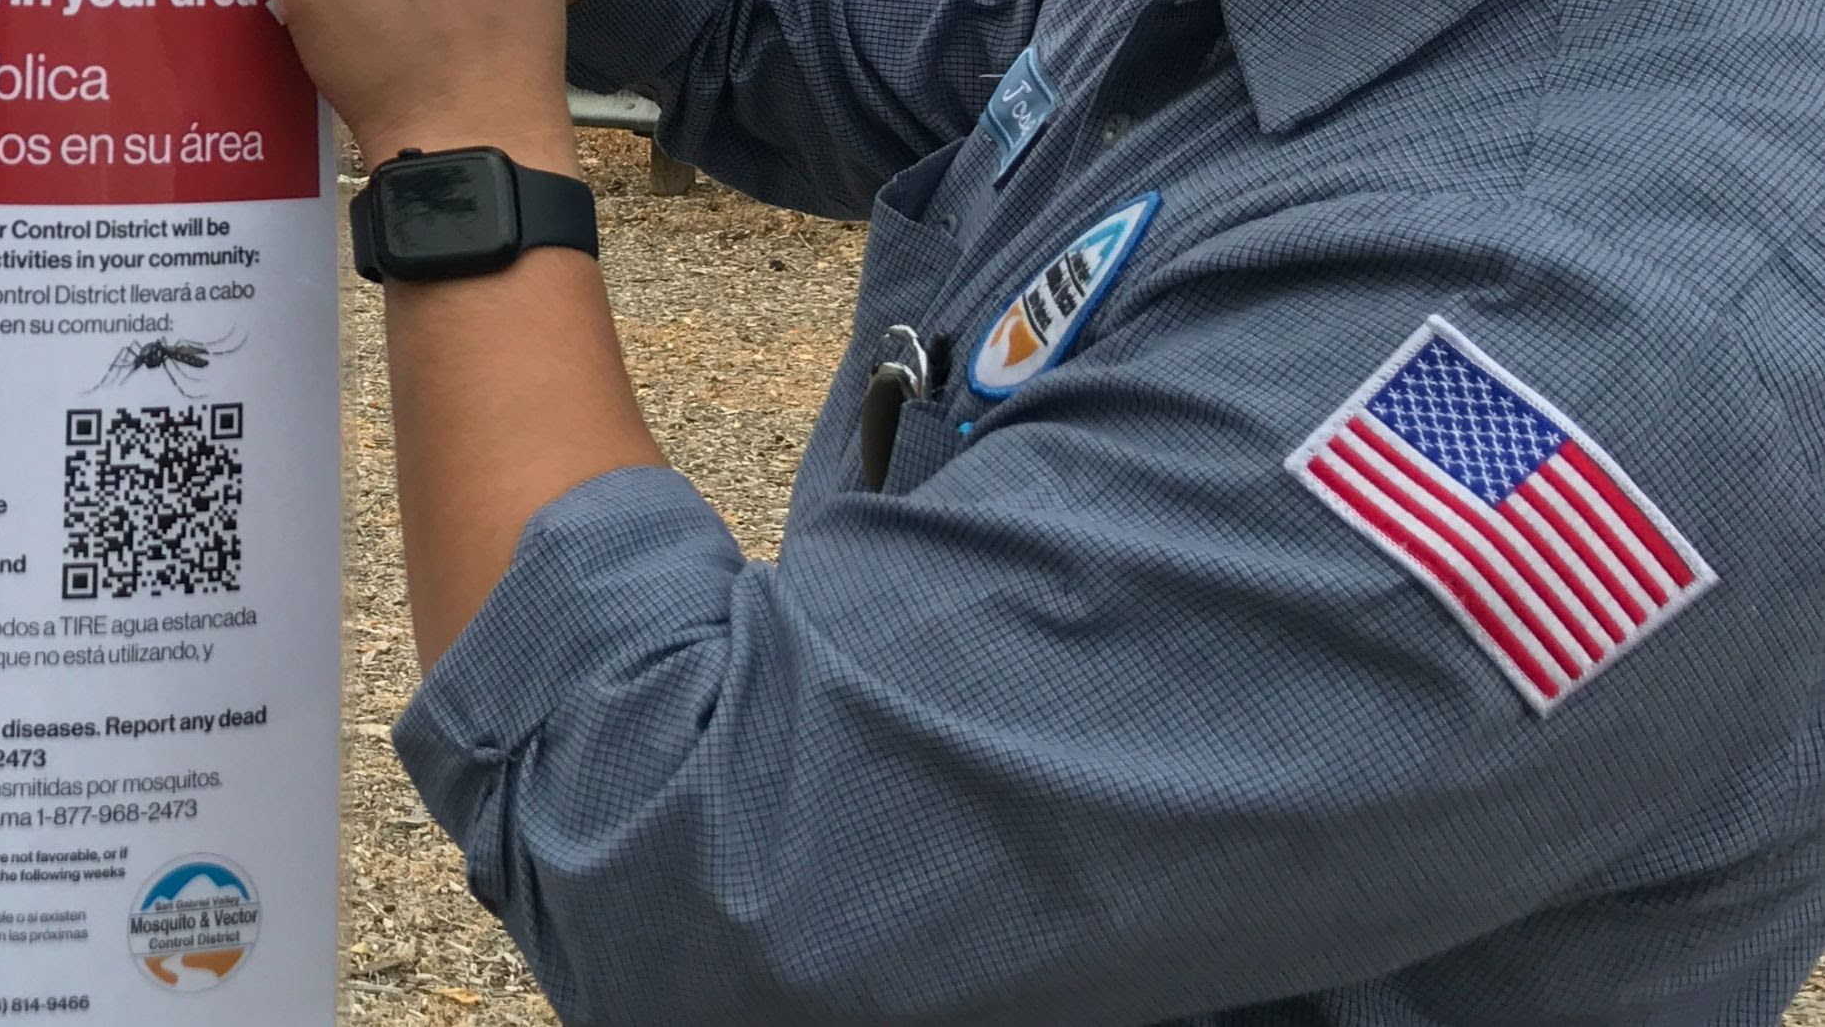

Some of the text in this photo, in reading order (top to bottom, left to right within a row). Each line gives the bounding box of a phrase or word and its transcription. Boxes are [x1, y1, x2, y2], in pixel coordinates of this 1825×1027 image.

[61, 134, 113, 165] en
[124, 134, 170, 164] su
[180, 122, 263, 163] área
[10, 219, 91, 239] Control
[95, 219, 168, 239] District
[171, 217, 203, 237] will
[206, 216, 230, 236] be
[76, 249, 95, 269] in
[98, 253, 145, 273] your
[148, 245, 259, 268] community:
[54, 284, 126, 305] District
[130, 281, 192, 304] llevará
[194, 285, 207, 302] a
[208, 280, 255, 301] cabo
[29, 318, 54, 335] su
[57, 312, 173, 335] comunidad:
[1, 718, 100, 739] diseases.
[105, 714, 176, 738] Report
[179, 714, 215, 733] any
[218, 704, 267, 728] dead
[86, 778, 120, 799] por
[122, 769, 222, 794] mosquitos.
[36, 798, 198, 826] 1-877-968-2473
[155, 896, 240, 910] San Gabriel Valley
[130, 909, 258, 935] Mosquito & Vector
[149, 930, 240, 950] Control District
